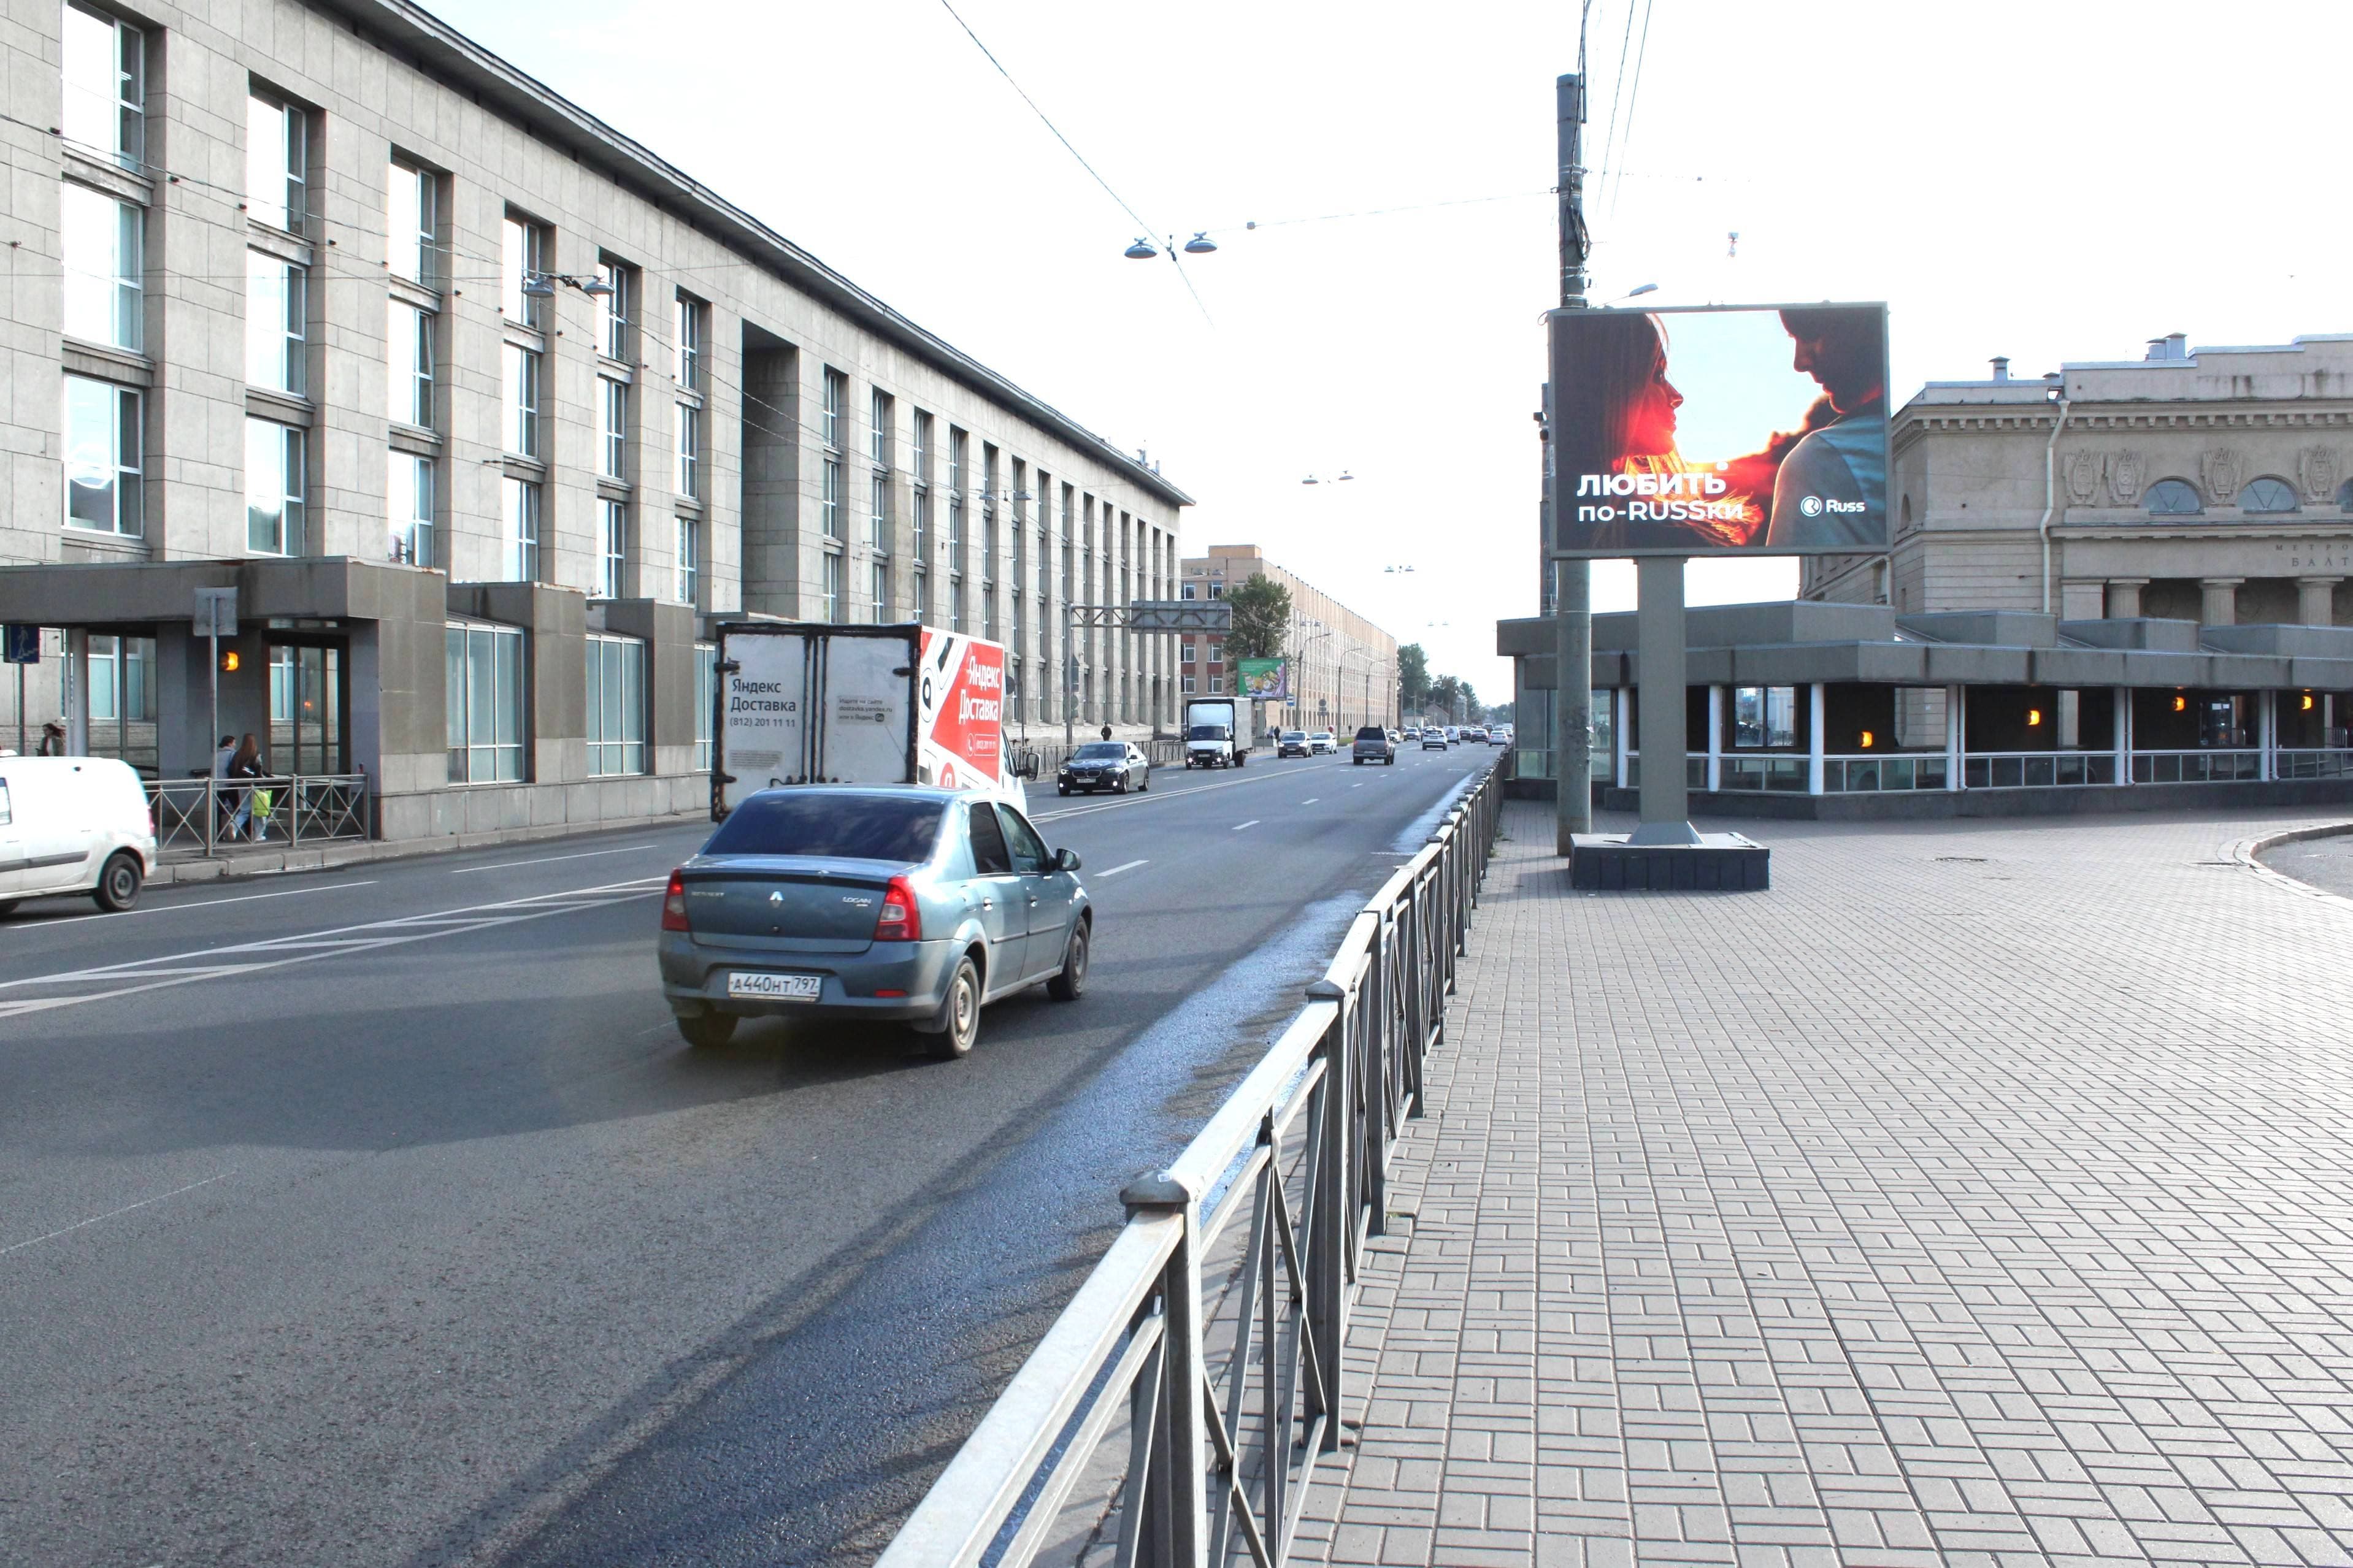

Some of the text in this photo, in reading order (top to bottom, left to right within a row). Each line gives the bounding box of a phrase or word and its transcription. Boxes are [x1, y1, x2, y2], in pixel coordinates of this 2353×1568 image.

[1576, 472, 1727, 497] ЛЮБИТЬ
[1578, 500, 1743, 522] по-RUSSки
[1825, 499, 1865, 513] Russ
[969, 655, 1000, 691] Яндекс
[732, 678, 781, 694] Яндекс
[731, 697, 796, 713] Доставка
[959, 689, 999, 724] Доставка
[730, 717, 796, 728] (812) 201 11 11
[794, 977, 817, 990] 797
